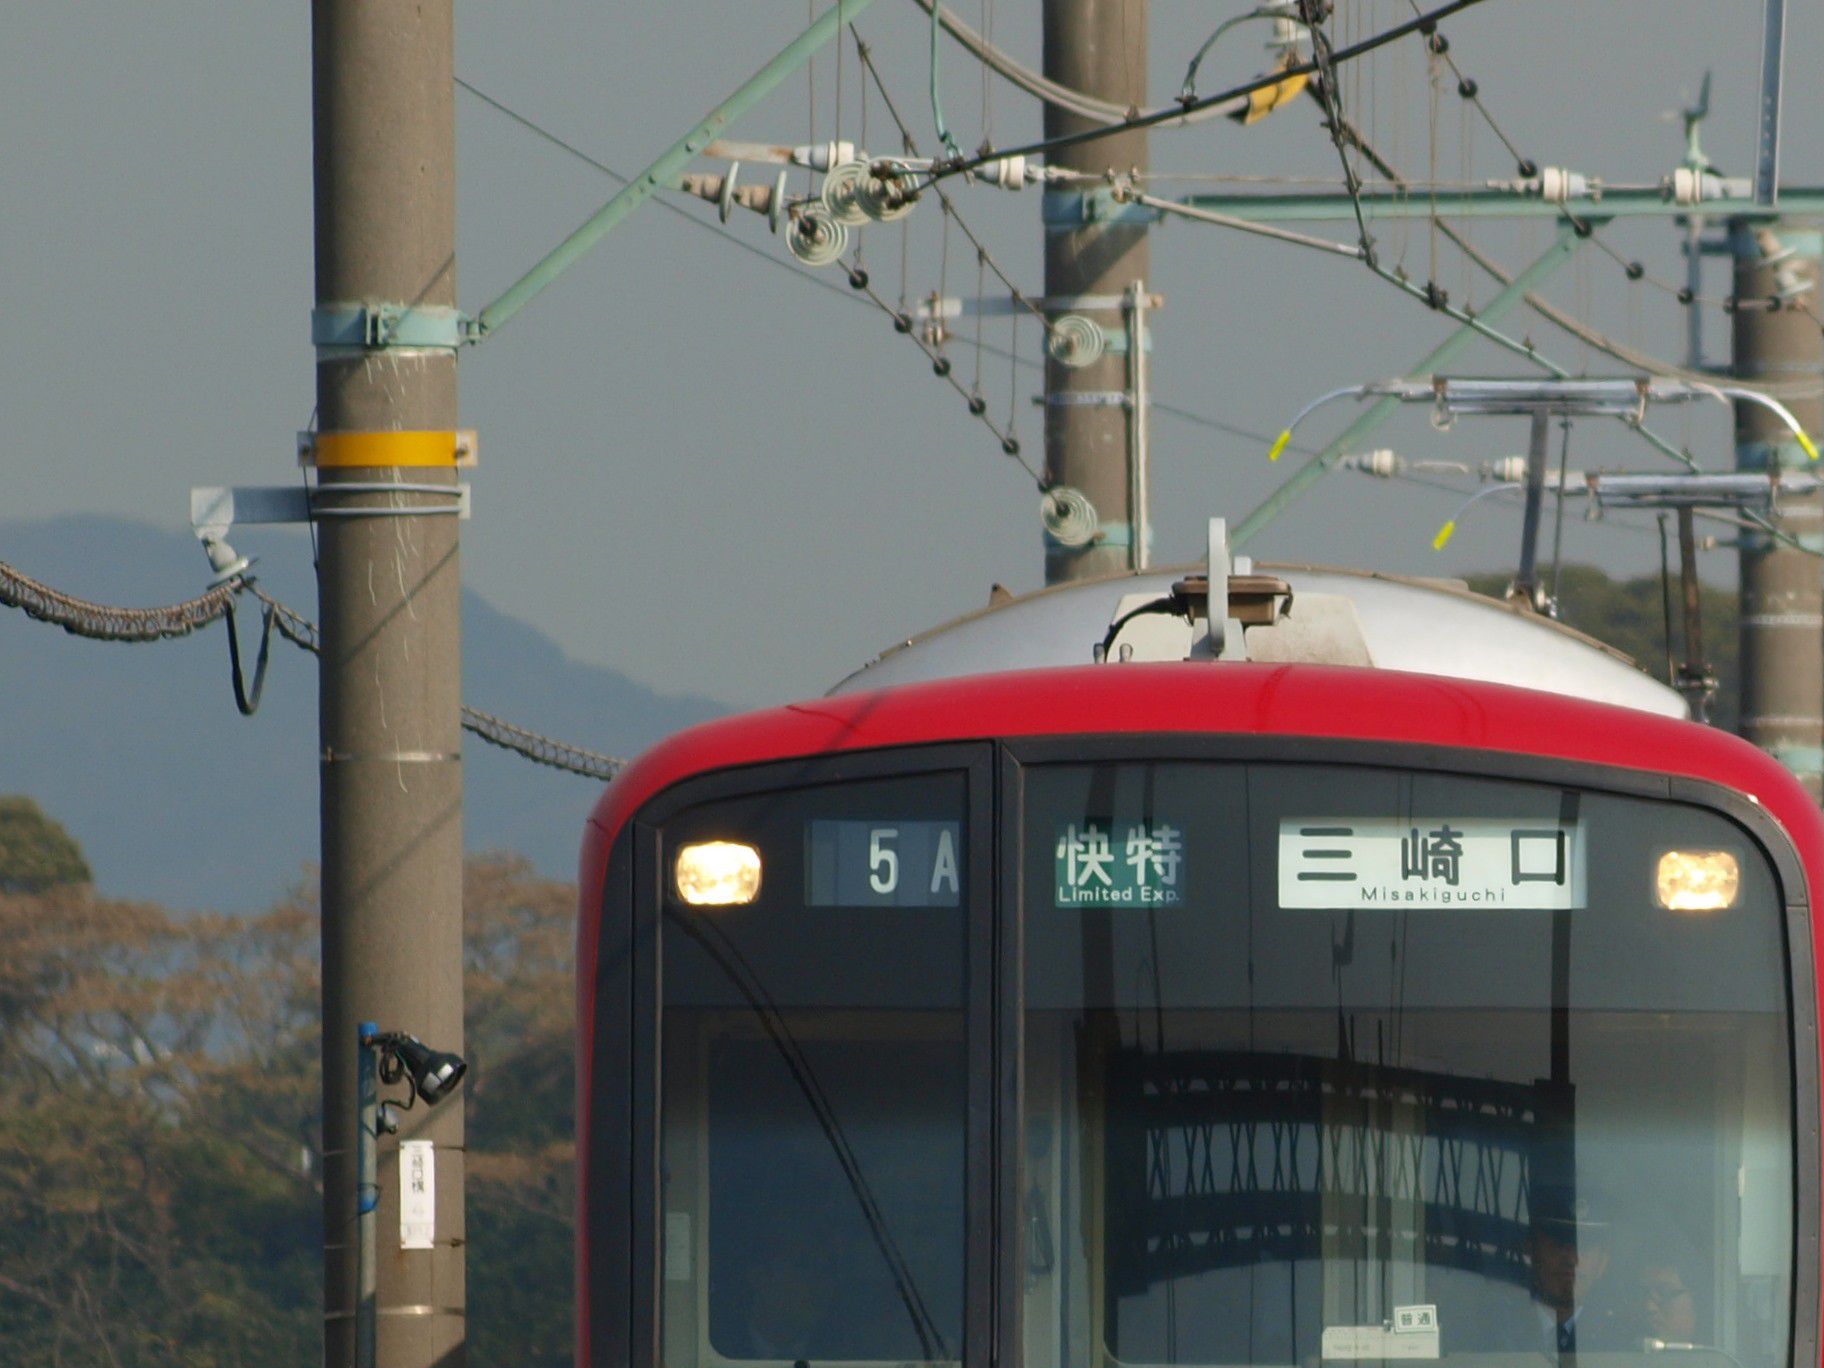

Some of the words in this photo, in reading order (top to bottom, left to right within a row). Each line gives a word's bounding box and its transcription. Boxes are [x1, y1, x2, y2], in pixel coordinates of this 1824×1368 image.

[869, 829, 899, 894] 5
[931, 829, 959, 893] A
[1056, 823, 1182, 886] 快特
[1297, 824, 1565, 886] 三崎口
[1059, 886, 1133, 902] Limited
[1140, 887, 1180, 903] Exp.
[1361, 887, 1505, 903] Misakiguchi
